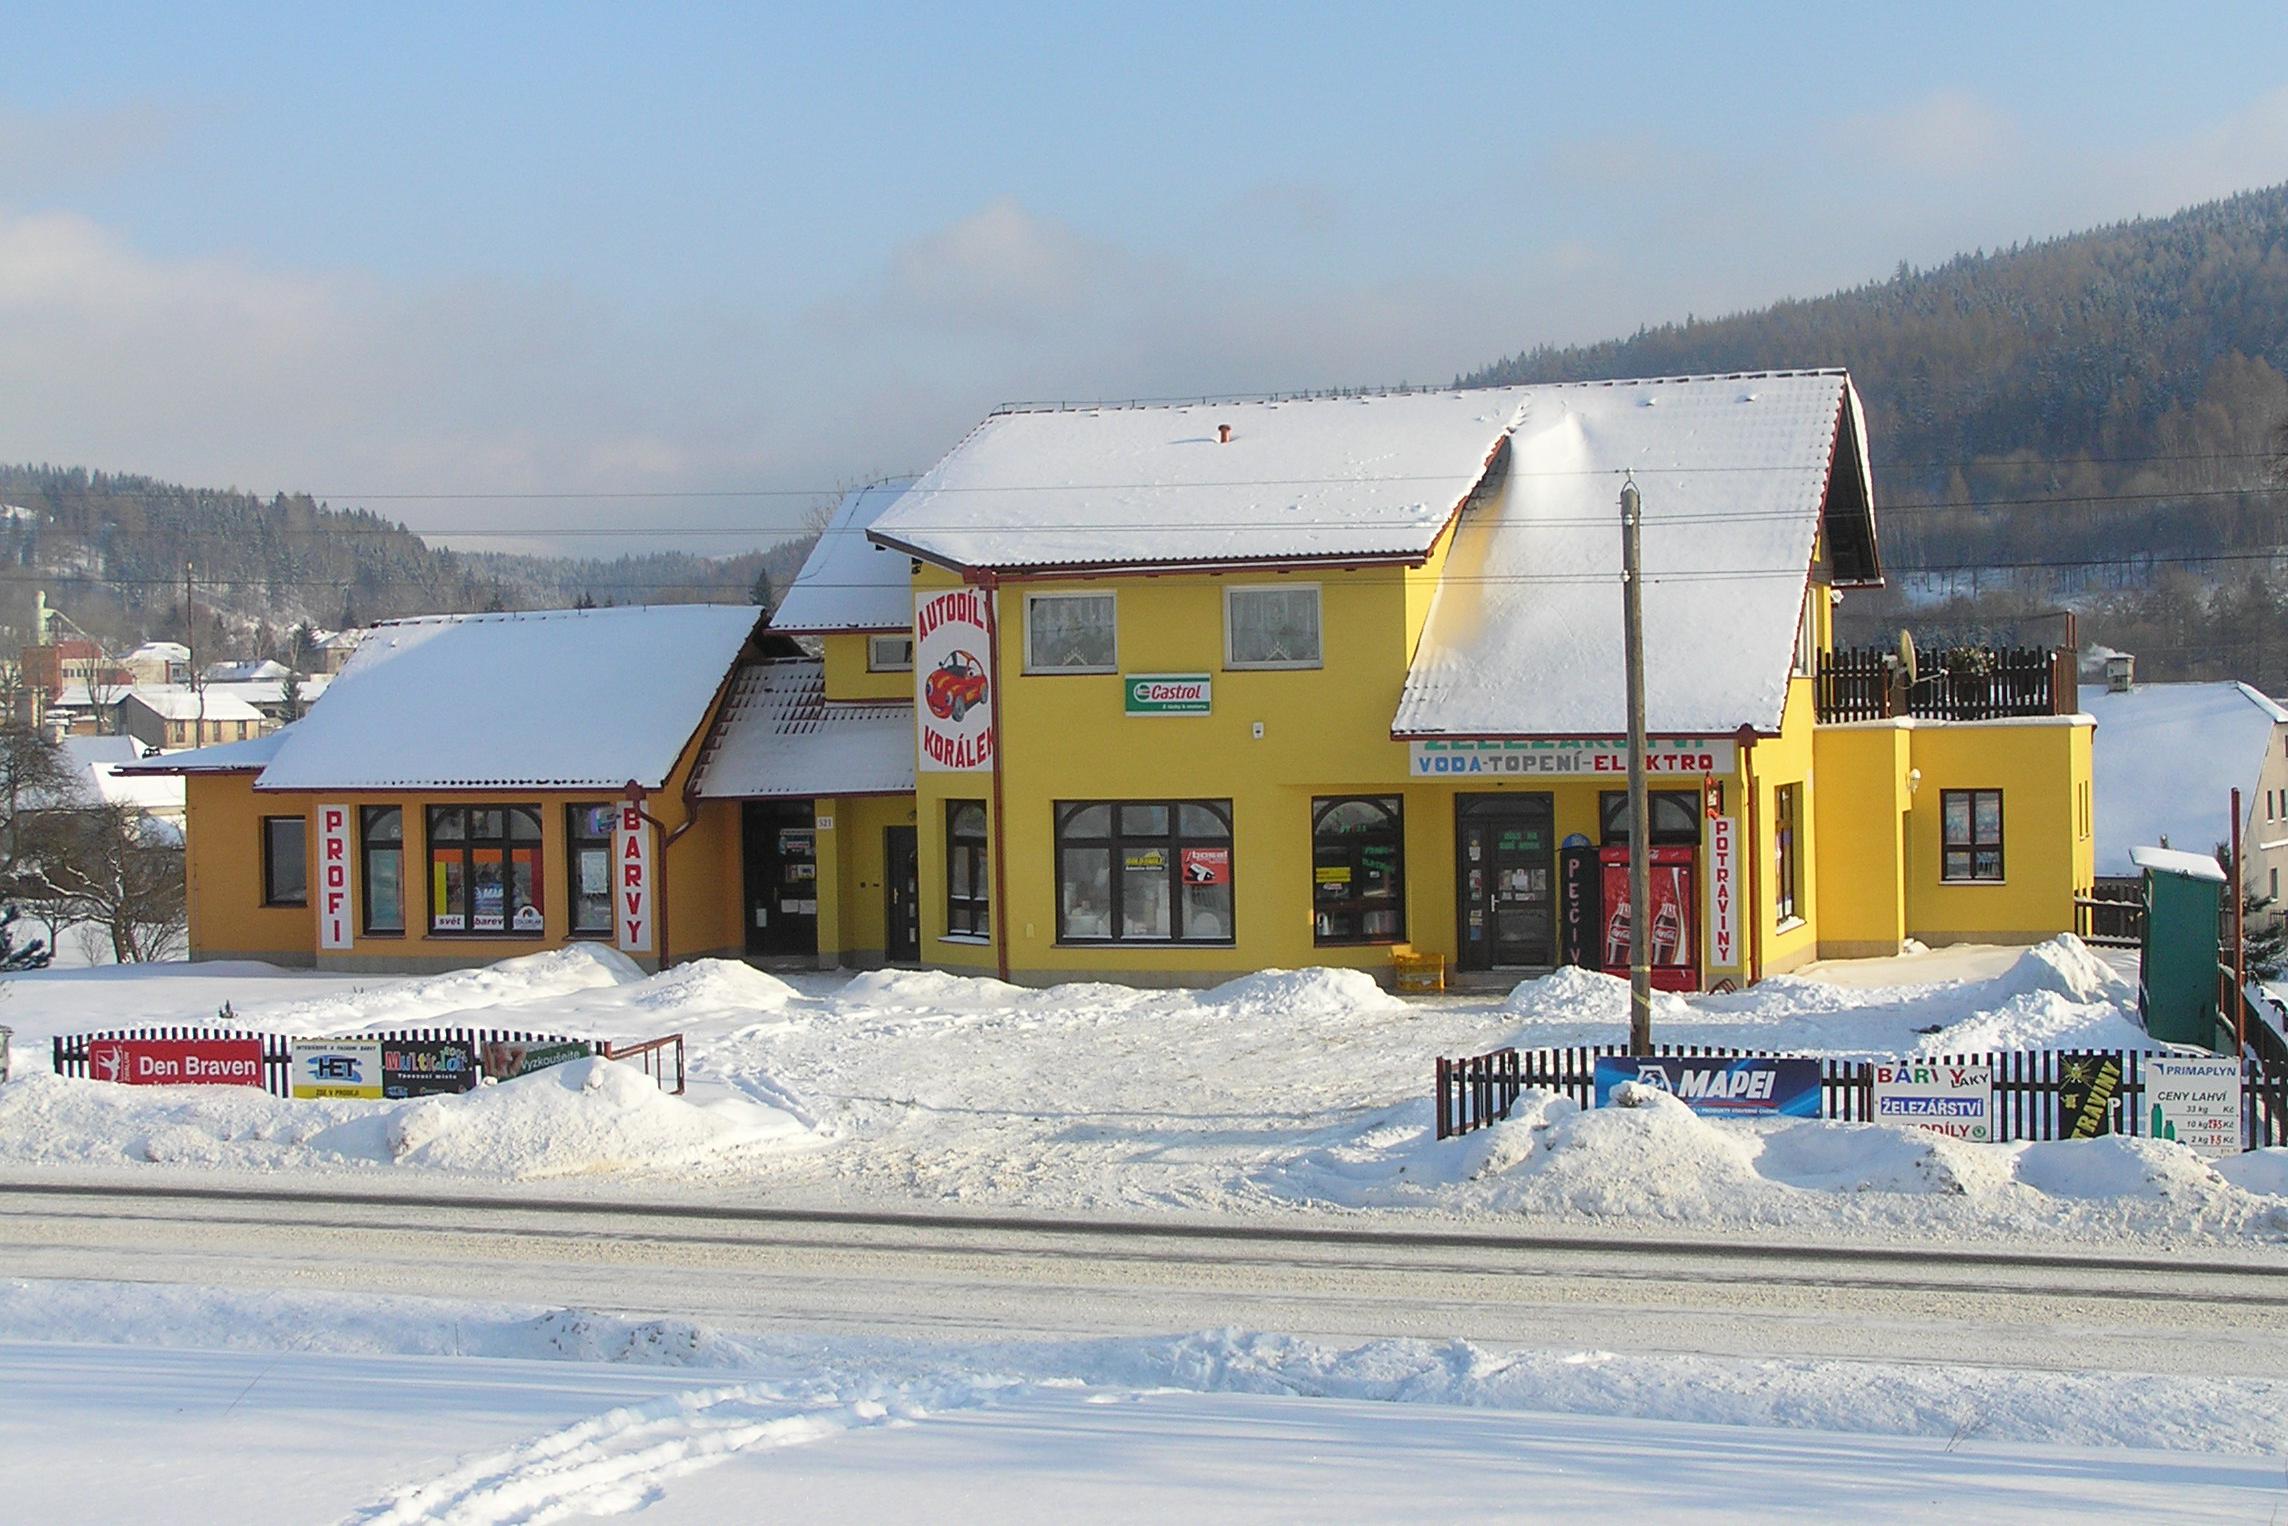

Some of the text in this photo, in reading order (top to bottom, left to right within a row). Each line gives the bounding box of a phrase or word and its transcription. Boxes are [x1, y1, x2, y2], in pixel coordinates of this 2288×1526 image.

[1151, 684, 1202, 700] Castrol
[1418, 751, 1713, 773] VODA-TOPENÍ-ELKTRO
[326, 810, 344, 942] PROFI
[623, 807, 642, 944] BARVY
[1715, 821, 1730, 962] POTRAVINY
[440, 916, 504, 926] svět barev
[139, 1056, 257, 1077] Den Braven
[318, 1057, 357, 1078] HET
[2166, 1065, 2237, 1077] PRIMAPLYN
[1677, 1069, 1777, 1100] MAPEI
[1951, 1073, 1989, 1089] LAKY
[2157, 1090, 2228, 1102] CENY LAHVÍ
[1881, 1097, 1982, 1116] ŽELEZÁŘSTVÍ
[2186, 1105, 2235, 1115] 33 kg Kč
[2187, 1120, 2197, 1129] 10
[2198, 1120, 2208, 1130] kg
[2223, 1120, 2235, 1129] Kč
[2191, 1135, 2197, 1143] 2
[2198, 1135, 2209, 1145] kg
[2222, 1135, 2235, 1144] Kč
